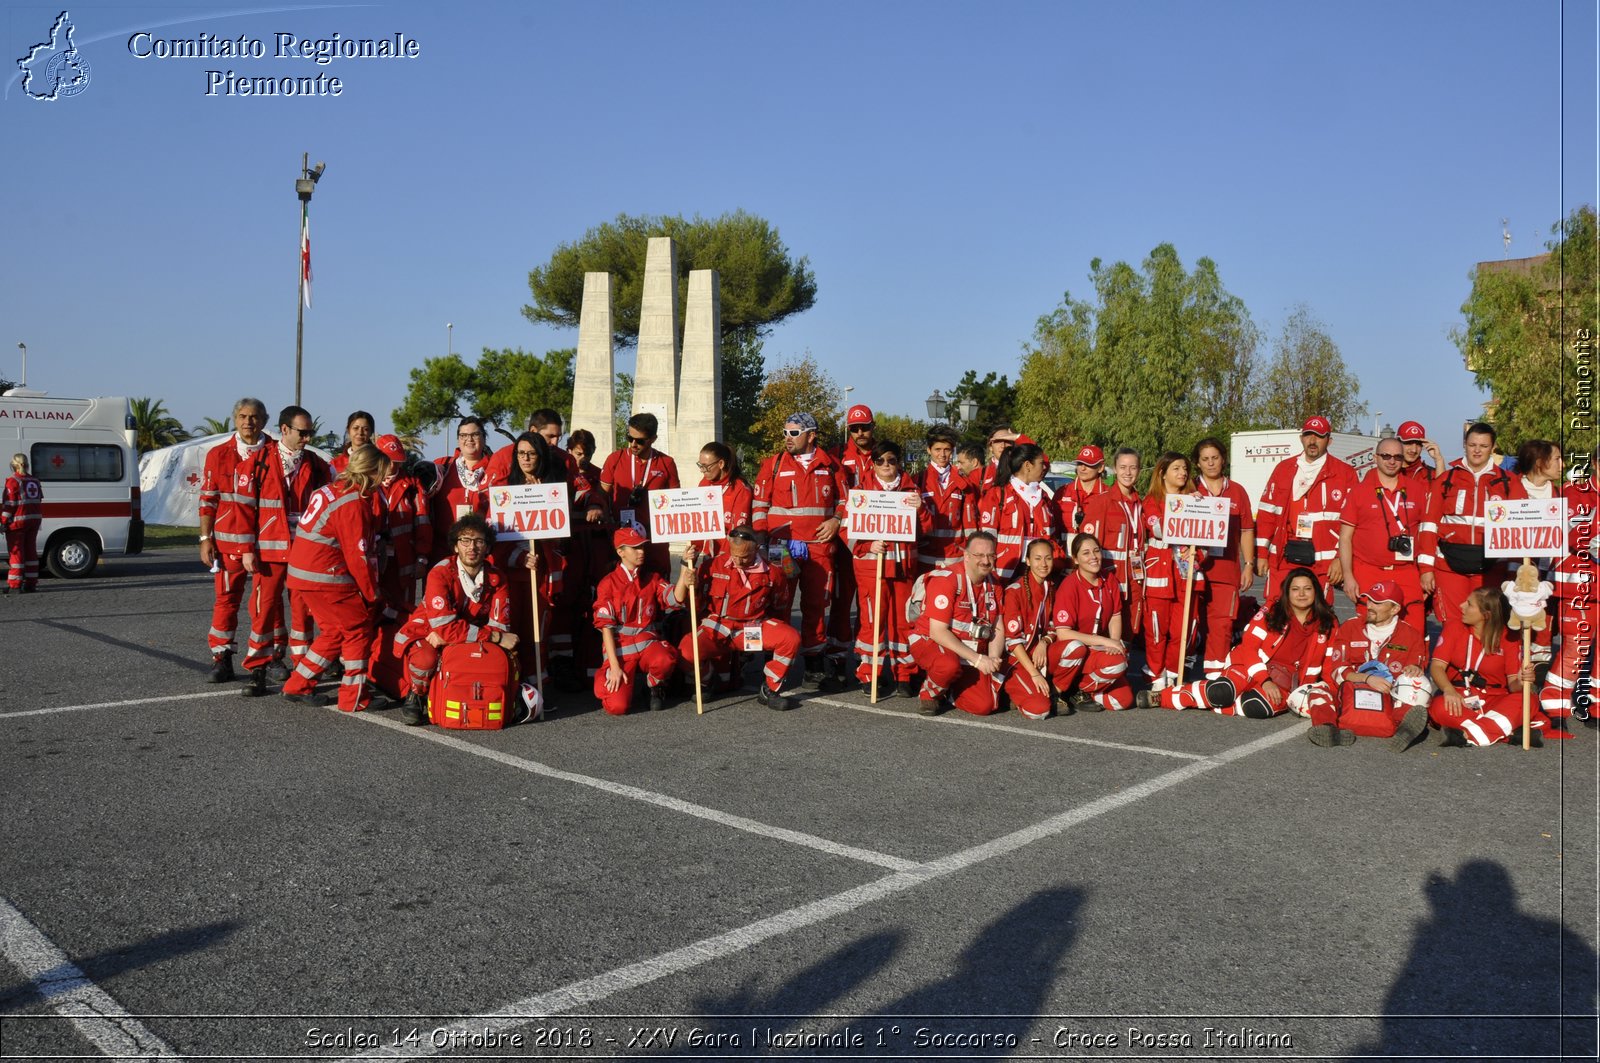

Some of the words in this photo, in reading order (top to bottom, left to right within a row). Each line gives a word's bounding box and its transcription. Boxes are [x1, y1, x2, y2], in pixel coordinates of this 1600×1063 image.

[13, 410, 74, 420] ITALIANA
[1351, 452, 1373, 467] SIC
[496, 508, 565, 533] LAZIO
[654, 511, 721, 536] UMBRIA
[852, 513, 912, 534] LIGURIA
[1167, 517, 1214, 539] SICILIA
[1218, 521, 1226, 540] 2
[1489, 526, 1562, 549] ABRUZZO
